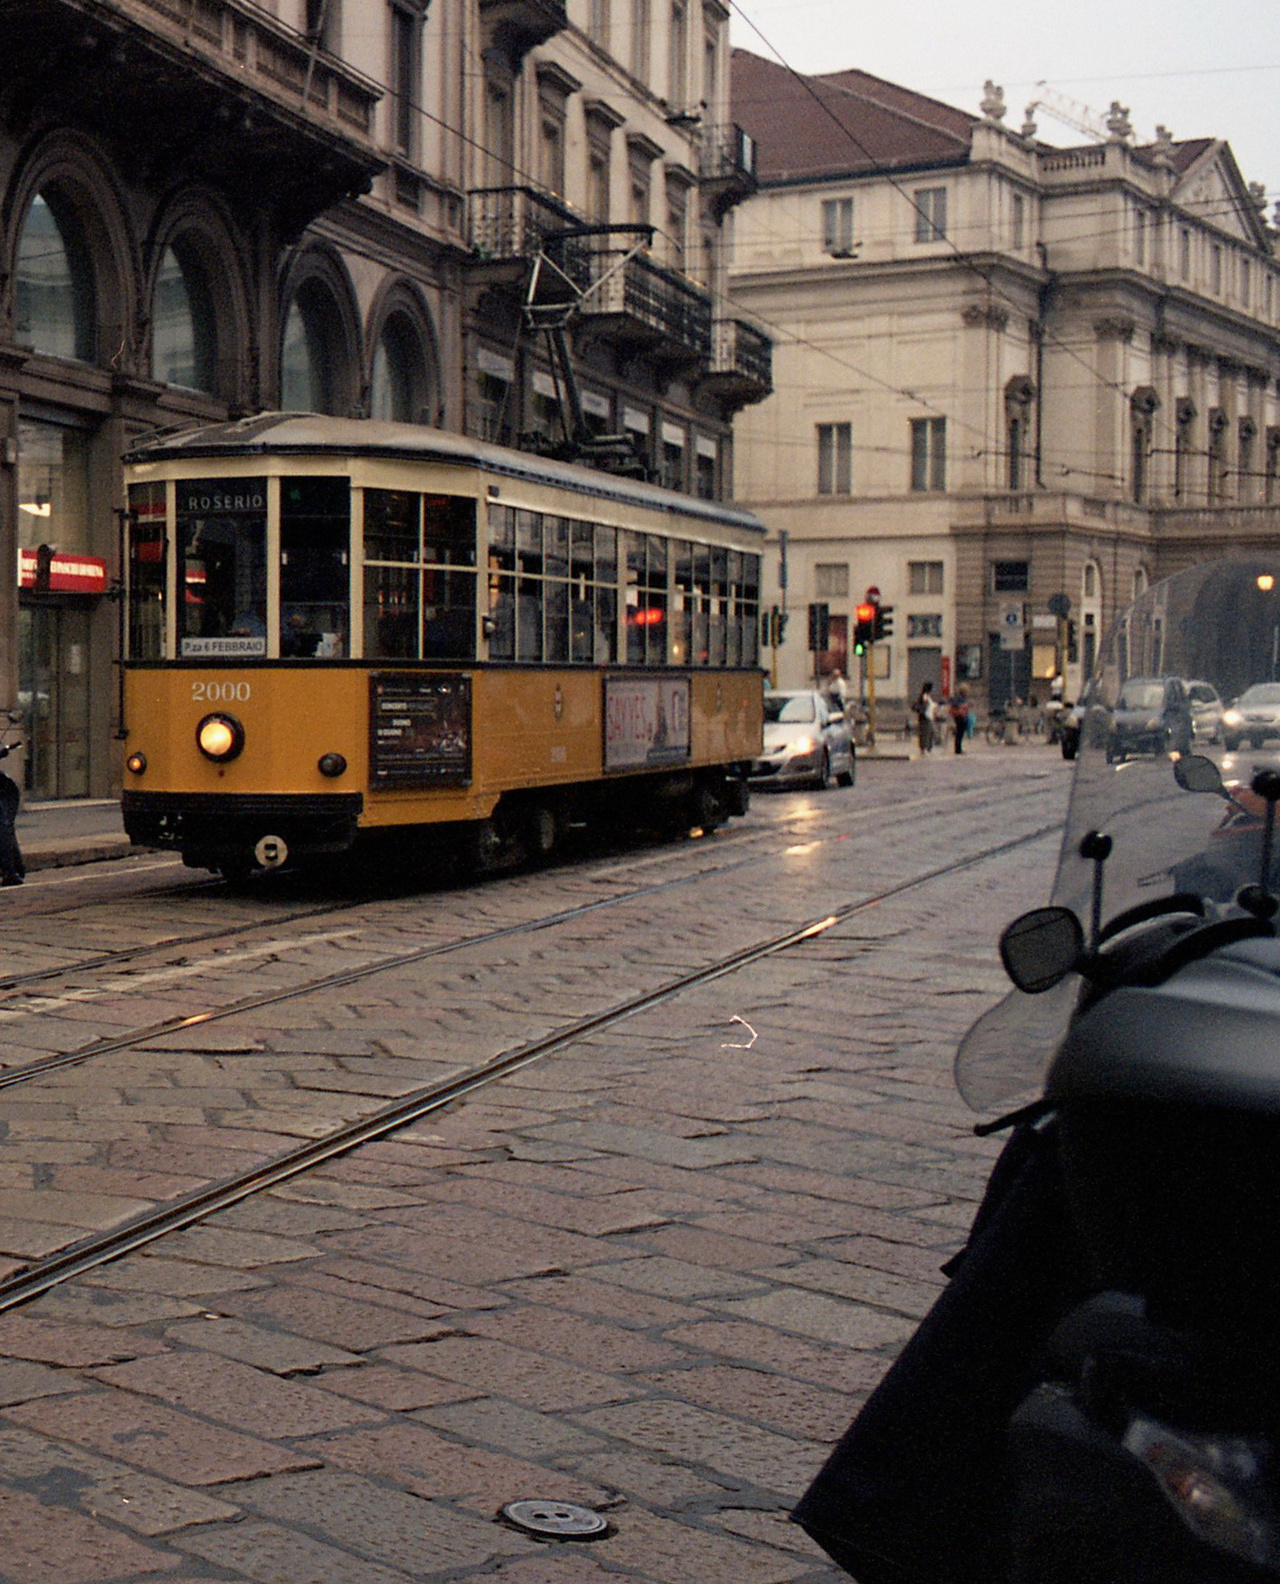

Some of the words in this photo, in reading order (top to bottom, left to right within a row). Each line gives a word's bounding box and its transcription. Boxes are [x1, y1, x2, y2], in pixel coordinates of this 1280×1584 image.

[188, 494, 263, 510] ROSERIO
[212, 640, 263, 652] FEBBRAIO
[191, 681, 252, 702] 2000
